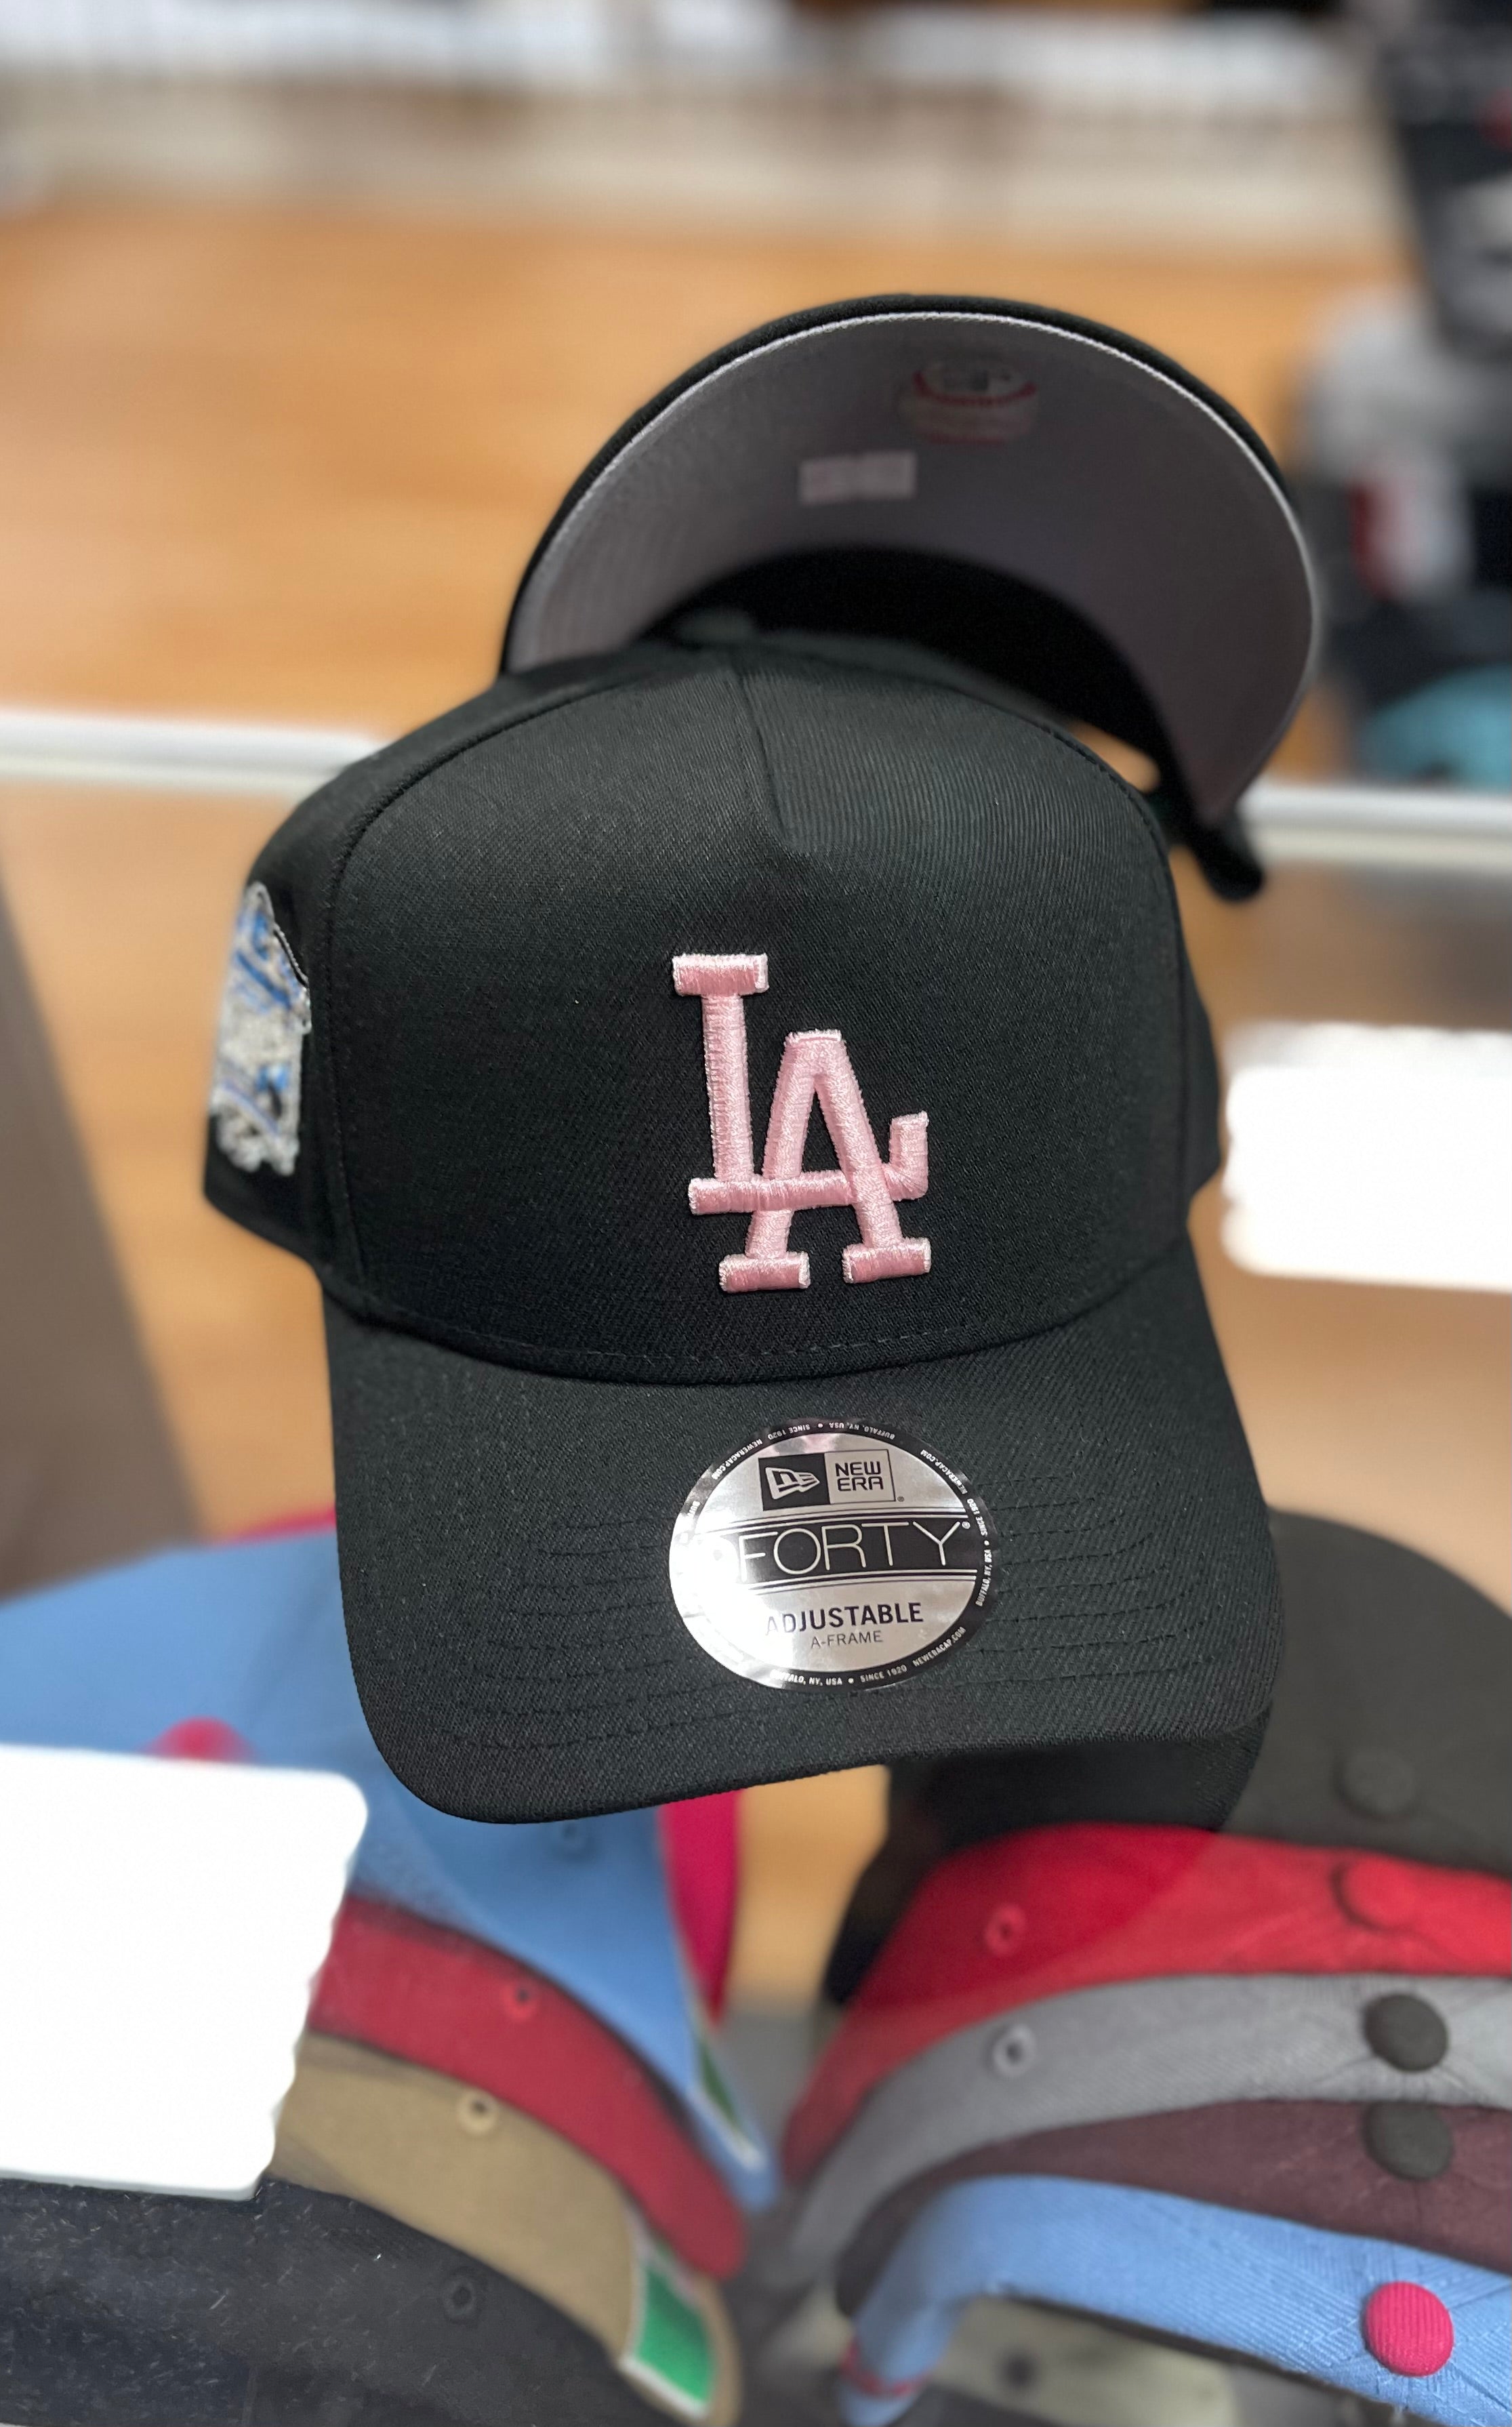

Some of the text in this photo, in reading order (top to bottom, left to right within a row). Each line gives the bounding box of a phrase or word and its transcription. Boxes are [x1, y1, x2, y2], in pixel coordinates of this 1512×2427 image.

[672, 953, 932, 1292] LA
[788, 1424, 811, 1434] SINCE
[712, 1439, 763, 1480] NEWERACAP.COM
[835, 1461, 882, 1477] NEW
[837, 1476, 884, 1492] ERA
[976, 1516, 988, 1536] SINCE
[983, 1549, 992, 1563] USA
[765, 1602, 924, 1636] ADJUSTABLE
[811, 1630, 884, 1649] A-FRAME
[809, 1677, 823, 1686] NY,
[825, 1677, 842, 1686] USA
[859, 1672, 884, 1683] SINCE
[886, 1664, 907, 1677] 1920
[912, 1626, 966, 1667] NEWERACAP.COM
